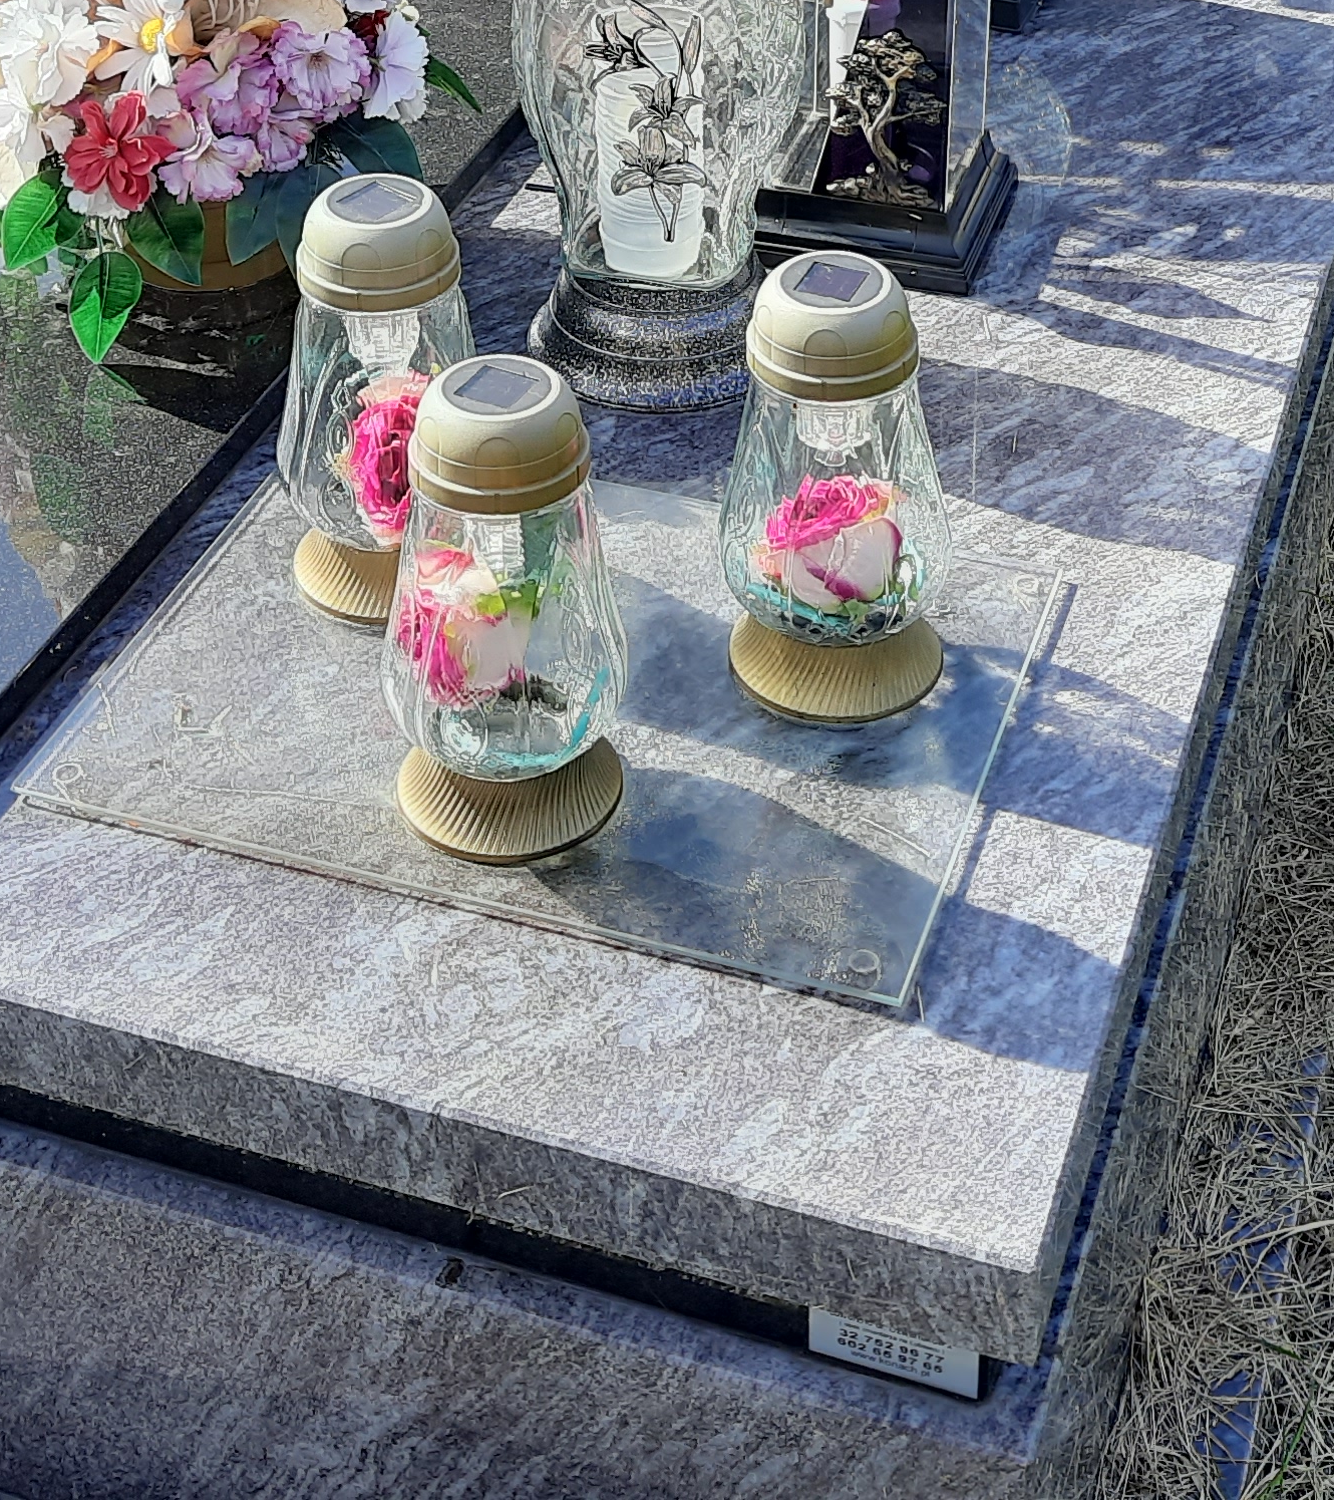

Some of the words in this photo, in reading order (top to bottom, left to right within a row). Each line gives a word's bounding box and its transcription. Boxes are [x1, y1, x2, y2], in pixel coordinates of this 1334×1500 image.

[837, 1337, 868, 1352] 602
[839, 1328, 859, 1340] 32
[924, 1352, 946, 1364] 77
